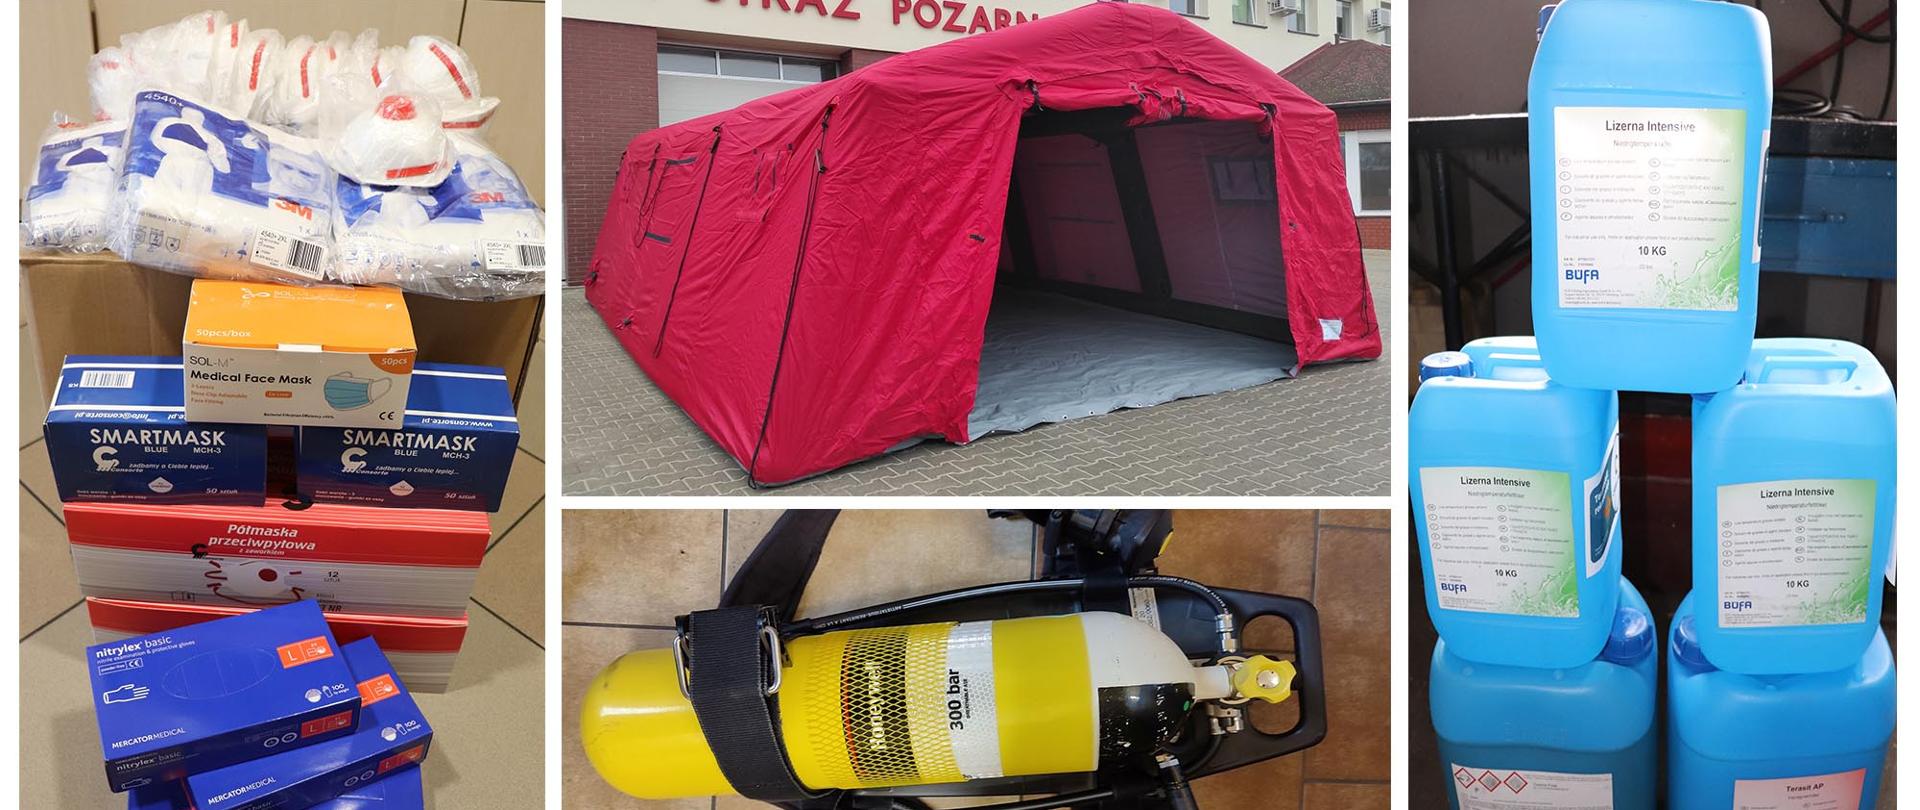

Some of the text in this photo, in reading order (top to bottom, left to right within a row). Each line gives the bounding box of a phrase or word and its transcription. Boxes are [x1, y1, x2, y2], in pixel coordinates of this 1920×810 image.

[144, 92, 186, 107] 4540+
[1605, 120, 1696, 133] Lizerna Intensive
[468, 191, 506, 204] 3M
[275, 196, 313, 221] 3M
[1638, 246, 1667, 256] 10 KG
[1565, 269, 1600, 284] BÜFA
[196, 328, 252, 338] 50pcs/box
[380, 356, 408, 367] 50pcs
[190, 370, 312, 385] Medical Face Mask
[75, 411, 149, 421] info@consorte.pl
[379, 411, 395, 421] CE
[421, 417, 494, 427] www.consorte.pl
[90, 428, 226, 447] SMARTMASK
[343, 430, 478, 452] SMARTMASK
[394, 449, 471, 460] BLUE MCH-3
[1460, 476, 1531, 488] Lizerna Intensive
[206, 487, 218, 495] 50
[444, 492, 457, 500] 50
[1760, 487, 1835, 499] Lizerna Intensive
[227, 524, 298, 538] Półmaska
[208, 536, 316, 551] przeciwpyłowa
[1494, 569, 1518, 578] 10 KG
[1786, 580, 1810, 588] 10 KG
[144, 636, 172, 648] basic
[287, 650, 299, 662] L
[331, 683, 345, 691] 100
[864, 661, 887, 750] Honeywell
[946, 668, 964, 731] 300 bar
[404, 719, 417, 728] 100
[112, 727, 186, 749] MERCATORMEDICAL
[158, 751, 182, 761] basic
[207, 776, 277, 805] MERCATORMEDICAL
[1786, 782, 1824, 792] Terasit AP
